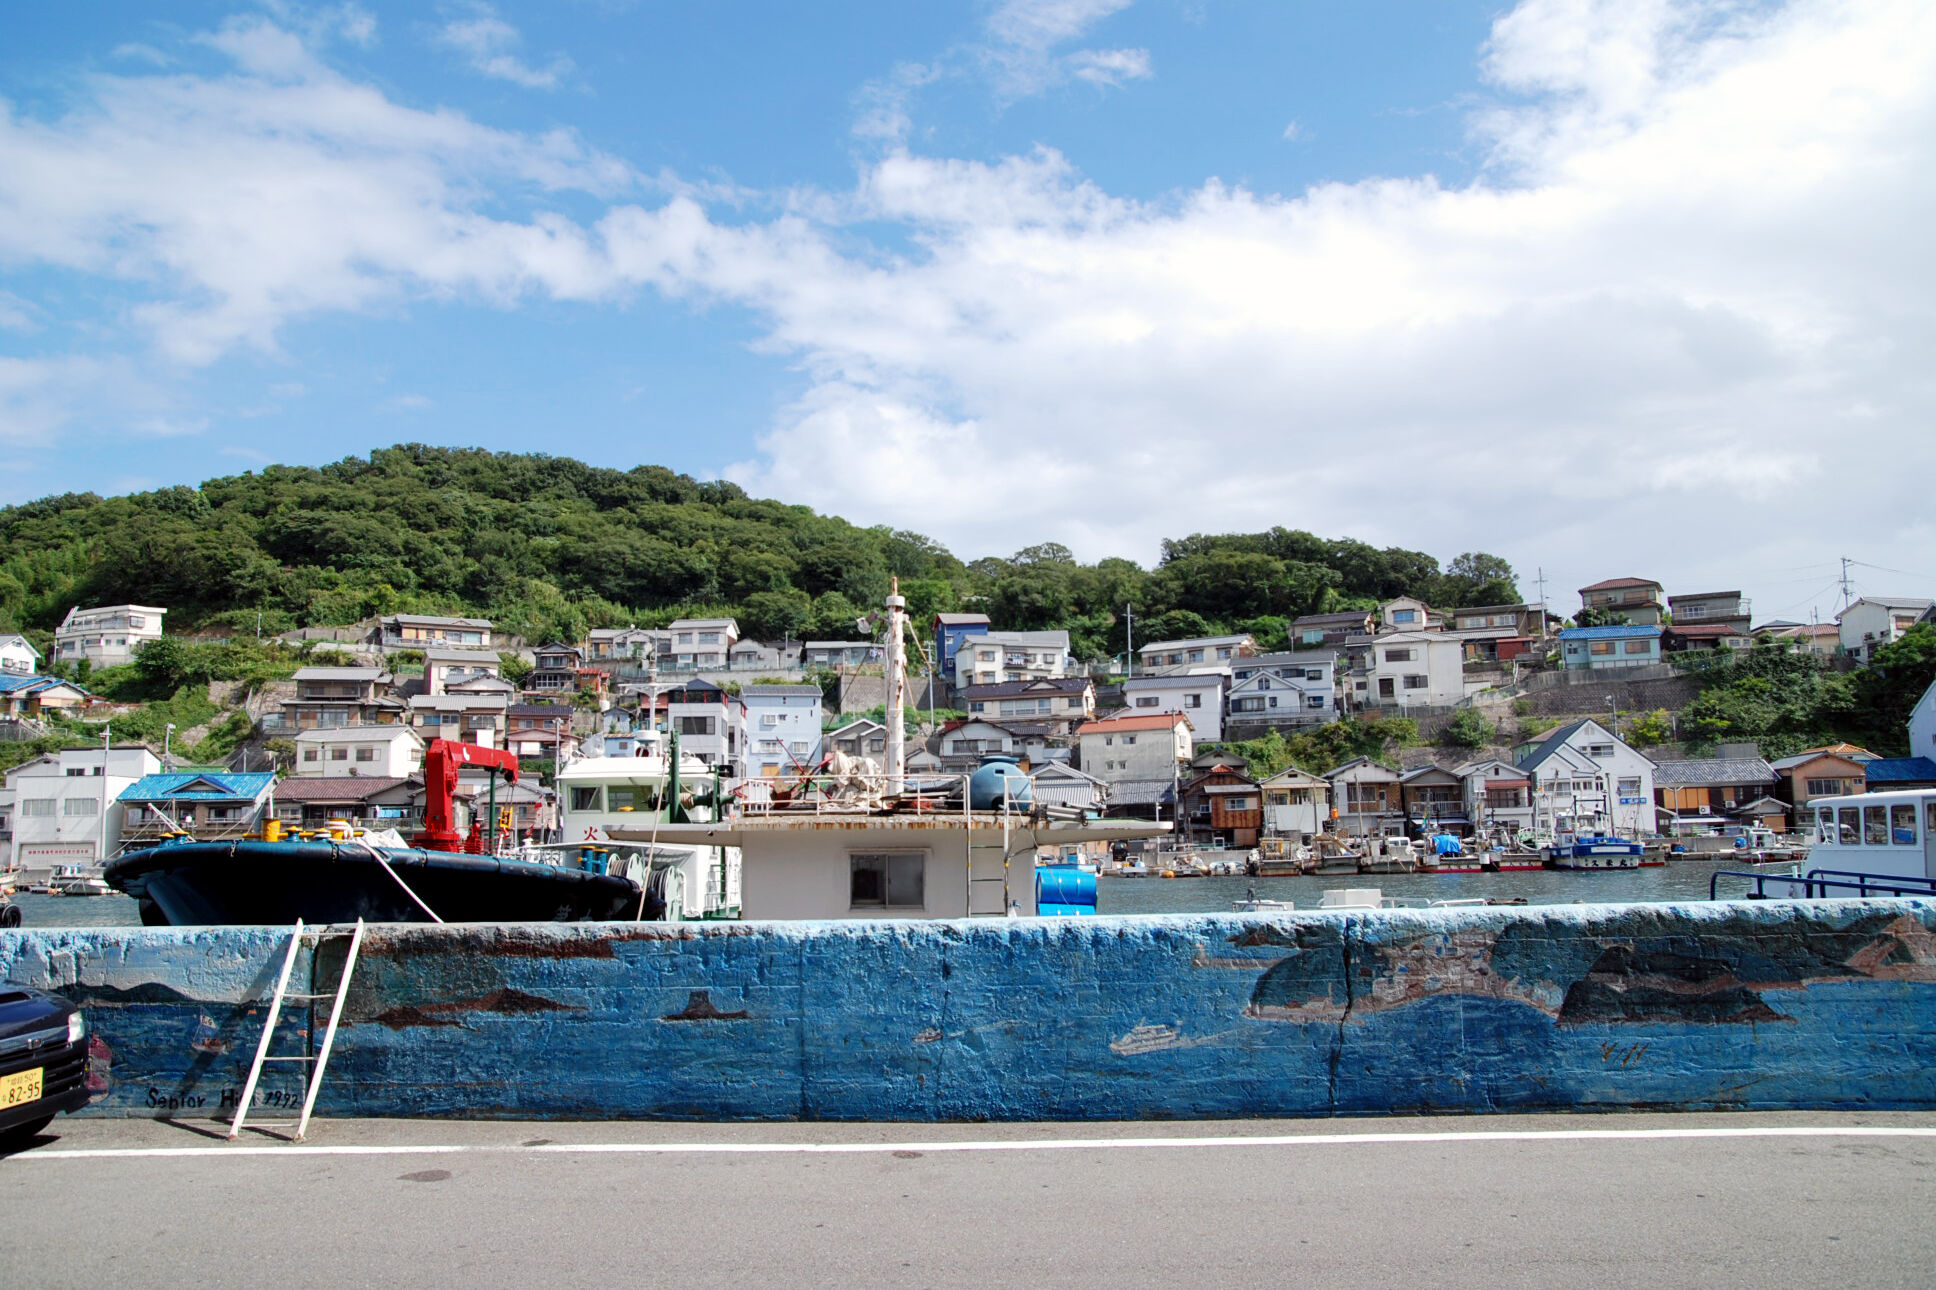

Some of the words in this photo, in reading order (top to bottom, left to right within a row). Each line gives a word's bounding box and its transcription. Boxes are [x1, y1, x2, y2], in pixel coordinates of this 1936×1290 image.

[584, 825, 598, 841] 火
[8, 1081, 40, 1104] 82-95
[147, 1087, 206, 1109] Senior
[264, 1090, 299, 1109] 1992
